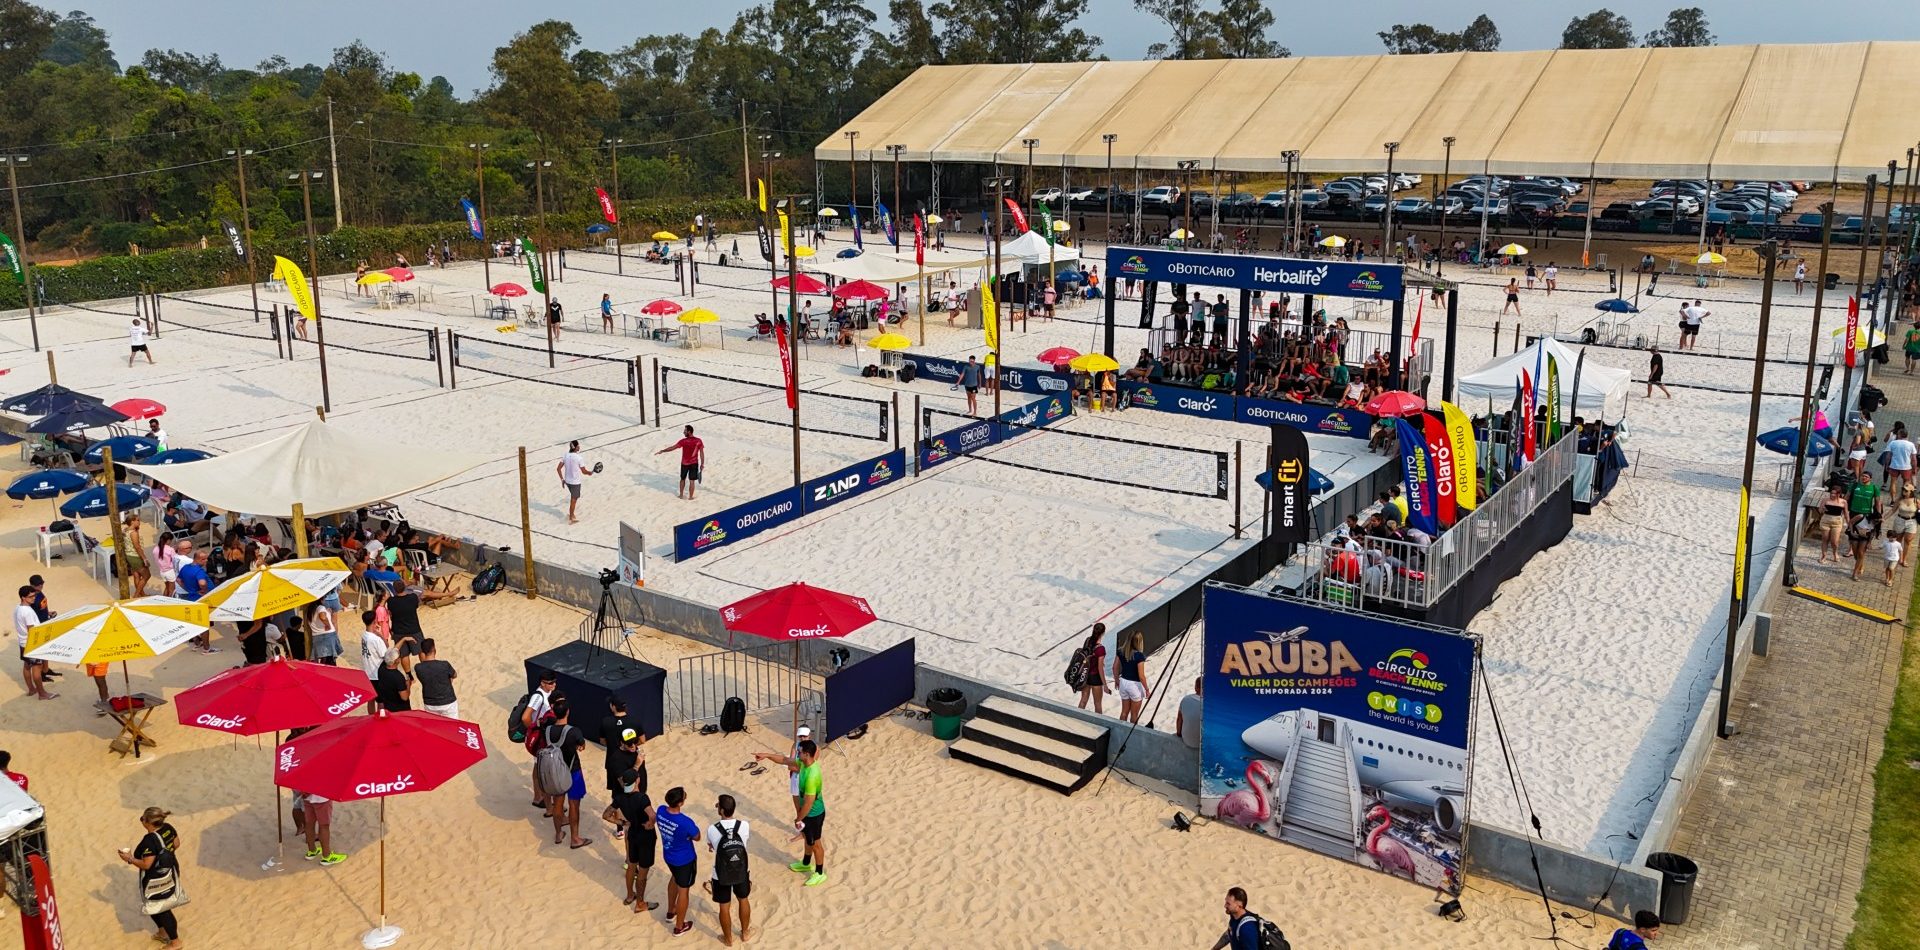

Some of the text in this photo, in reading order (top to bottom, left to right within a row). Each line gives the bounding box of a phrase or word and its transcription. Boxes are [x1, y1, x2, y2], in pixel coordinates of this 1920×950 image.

[229, 227, 244, 255] ZAND
[760, 225, 770, 255] ZAND
[1253, 267, 1320, 290] Herbalife
[1847, 316, 1856, 350] Claro
[1009, 371, 1023, 385] fit
[1178, 397, 1211, 412] Claro
[1436, 446, 1452, 497] Claro
[815, 473, 860, 501] ZAND
[1277, 459, 1297, 527] smart fit
[1406, 456, 1421, 511] CIRCUITO
[789, 628, 825, 638] Claro
[1220, 640, 1364, 676] ARUBA
[1231, 676, 1358, 688] VIAGEM DOS CAMPEÕES
[1377, 661, 1437, 680] CIRCUITO
[328, 695, 360, 715] Claro
[1374, 696, 1437, 718] TWISY
[196, 713, 236, 729] Claro
[1369, 709, 1439, 733] the world is yours
[356, 780, 406, 796] Claro
